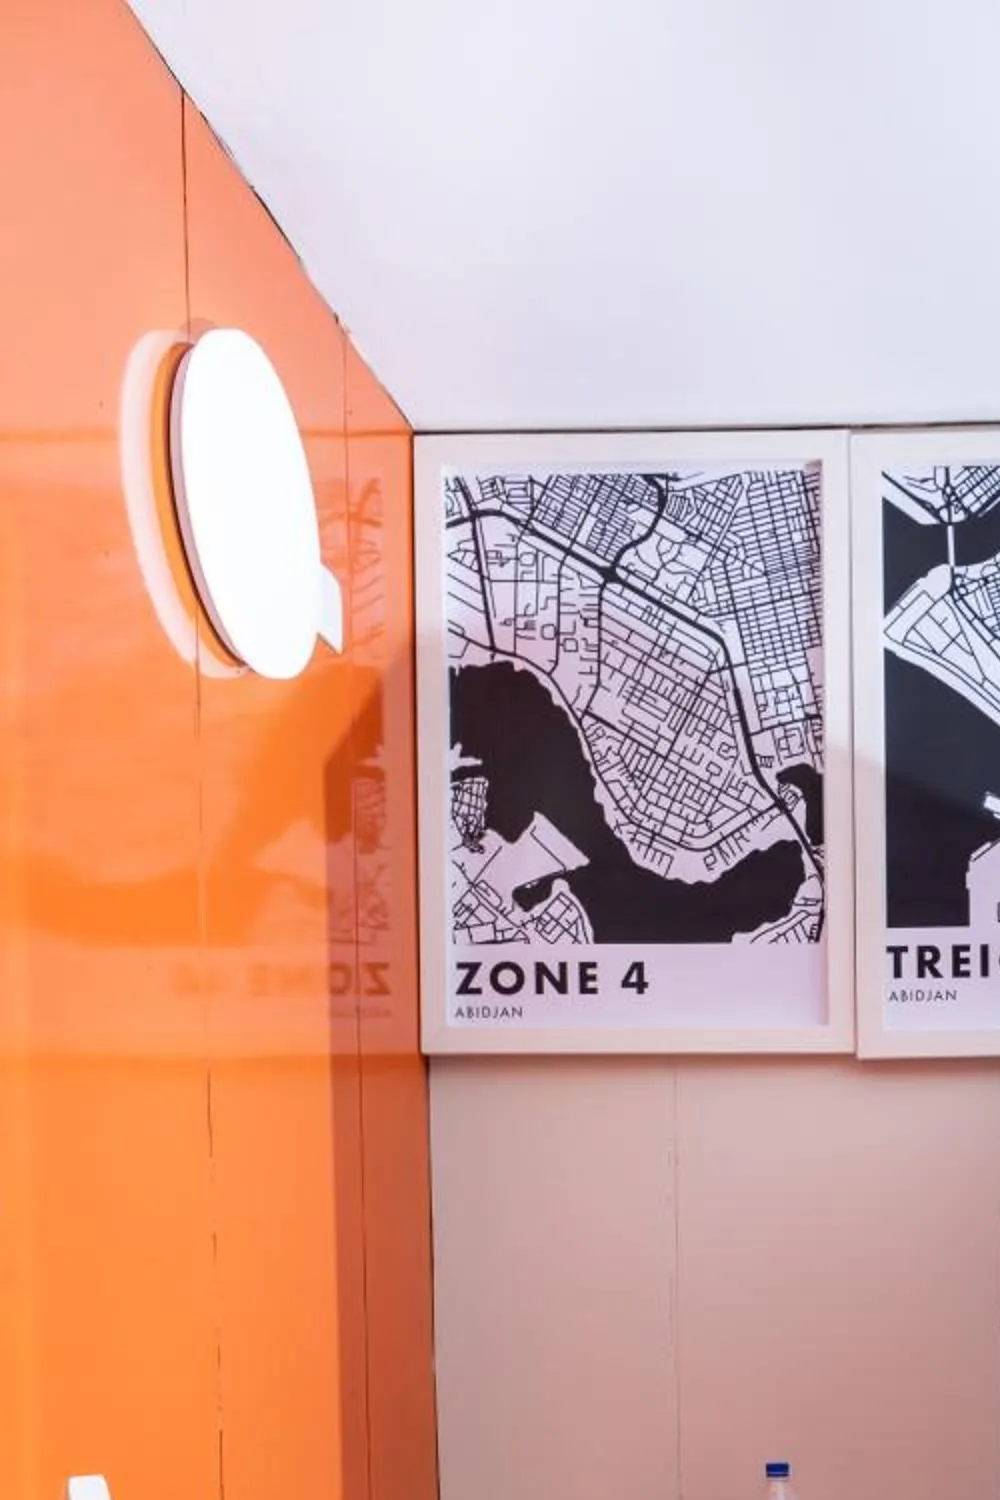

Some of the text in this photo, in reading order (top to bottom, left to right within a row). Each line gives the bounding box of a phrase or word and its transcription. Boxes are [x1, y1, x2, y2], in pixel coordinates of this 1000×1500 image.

[455, 961, 650, 996] ZONE 4
[888, 988, 958, 1003] ABIDJAN
[454, 1006, 524, 1019] ABIDJAN
